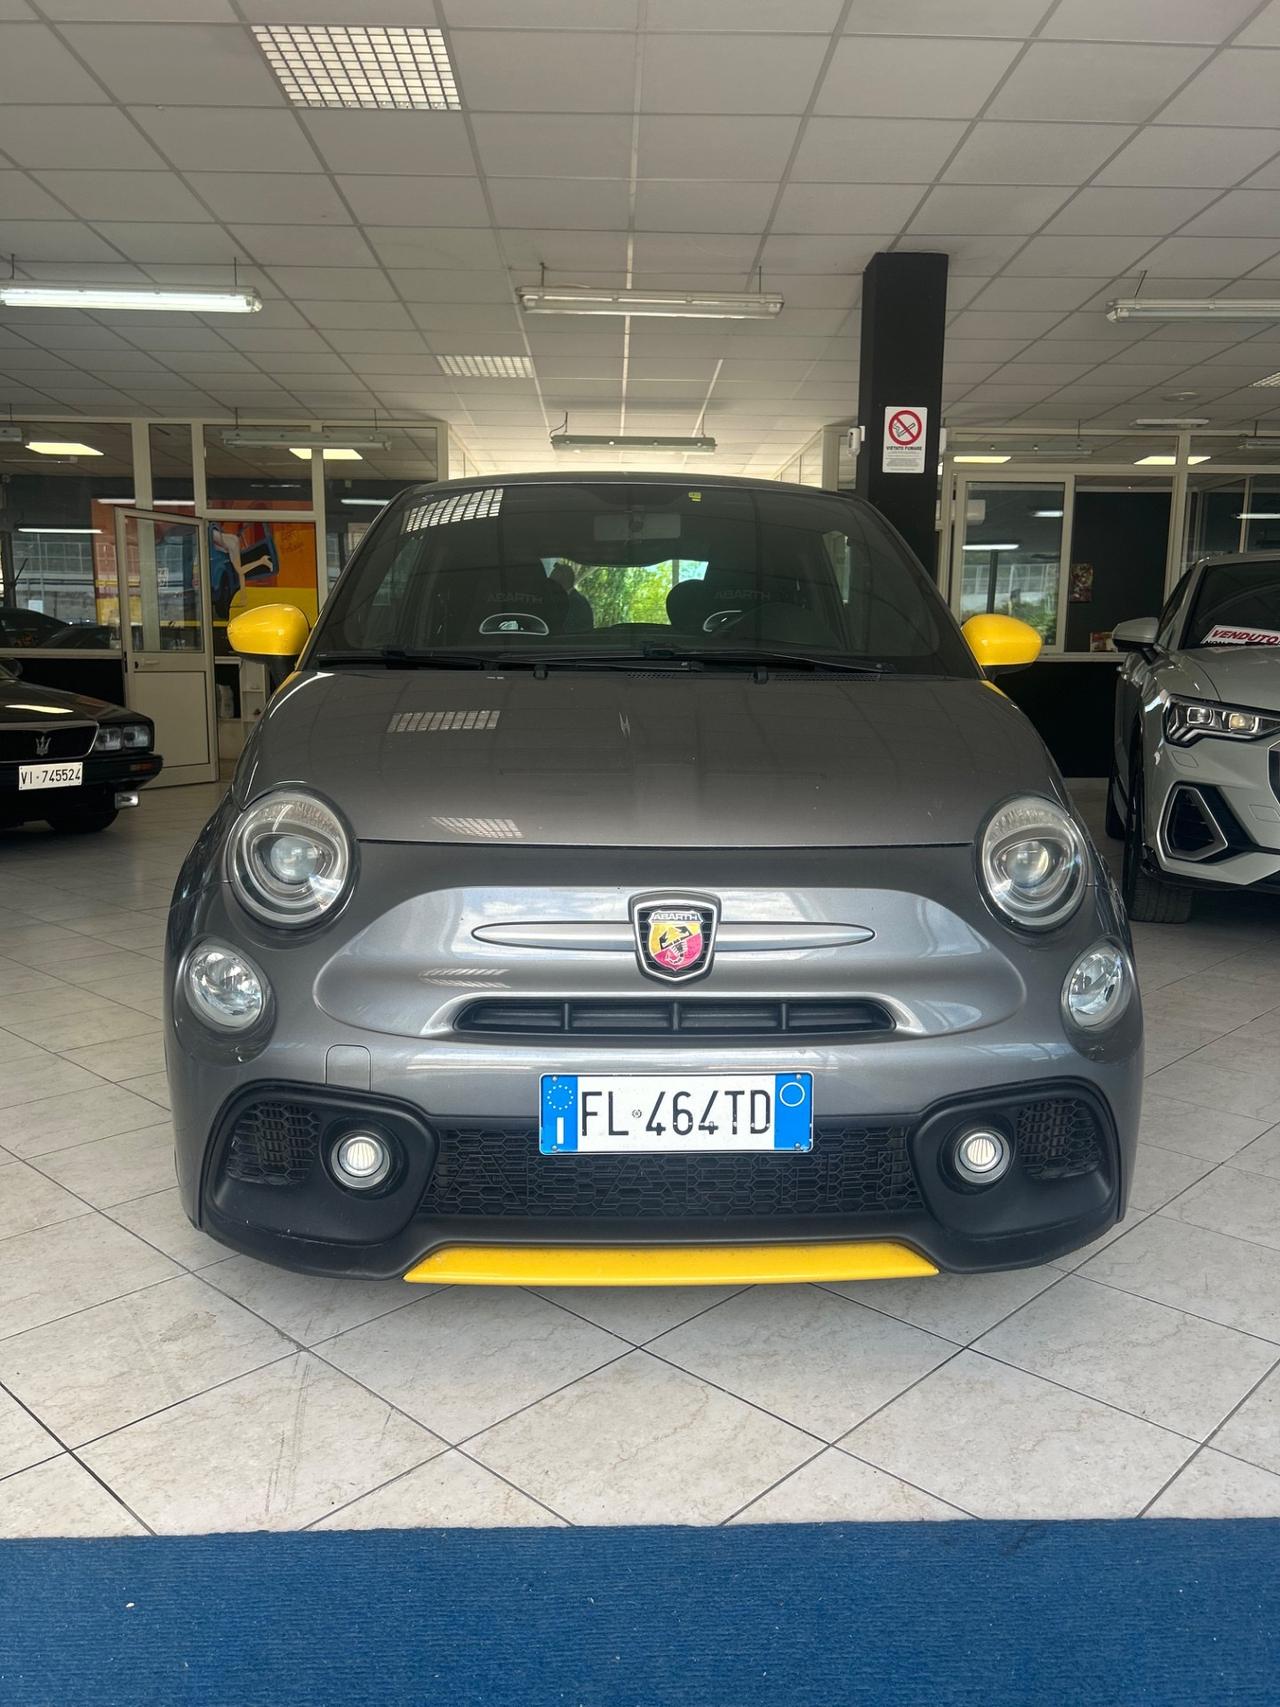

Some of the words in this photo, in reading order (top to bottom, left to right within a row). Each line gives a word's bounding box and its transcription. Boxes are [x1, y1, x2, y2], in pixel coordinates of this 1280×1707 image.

[1211, 630, 1278, 644] VENDUTO
[654, 913, 698, 921] ABARTH
[581, 1091, 629, 1137] FL
[645, 1089, 771, 1136] 464TD
